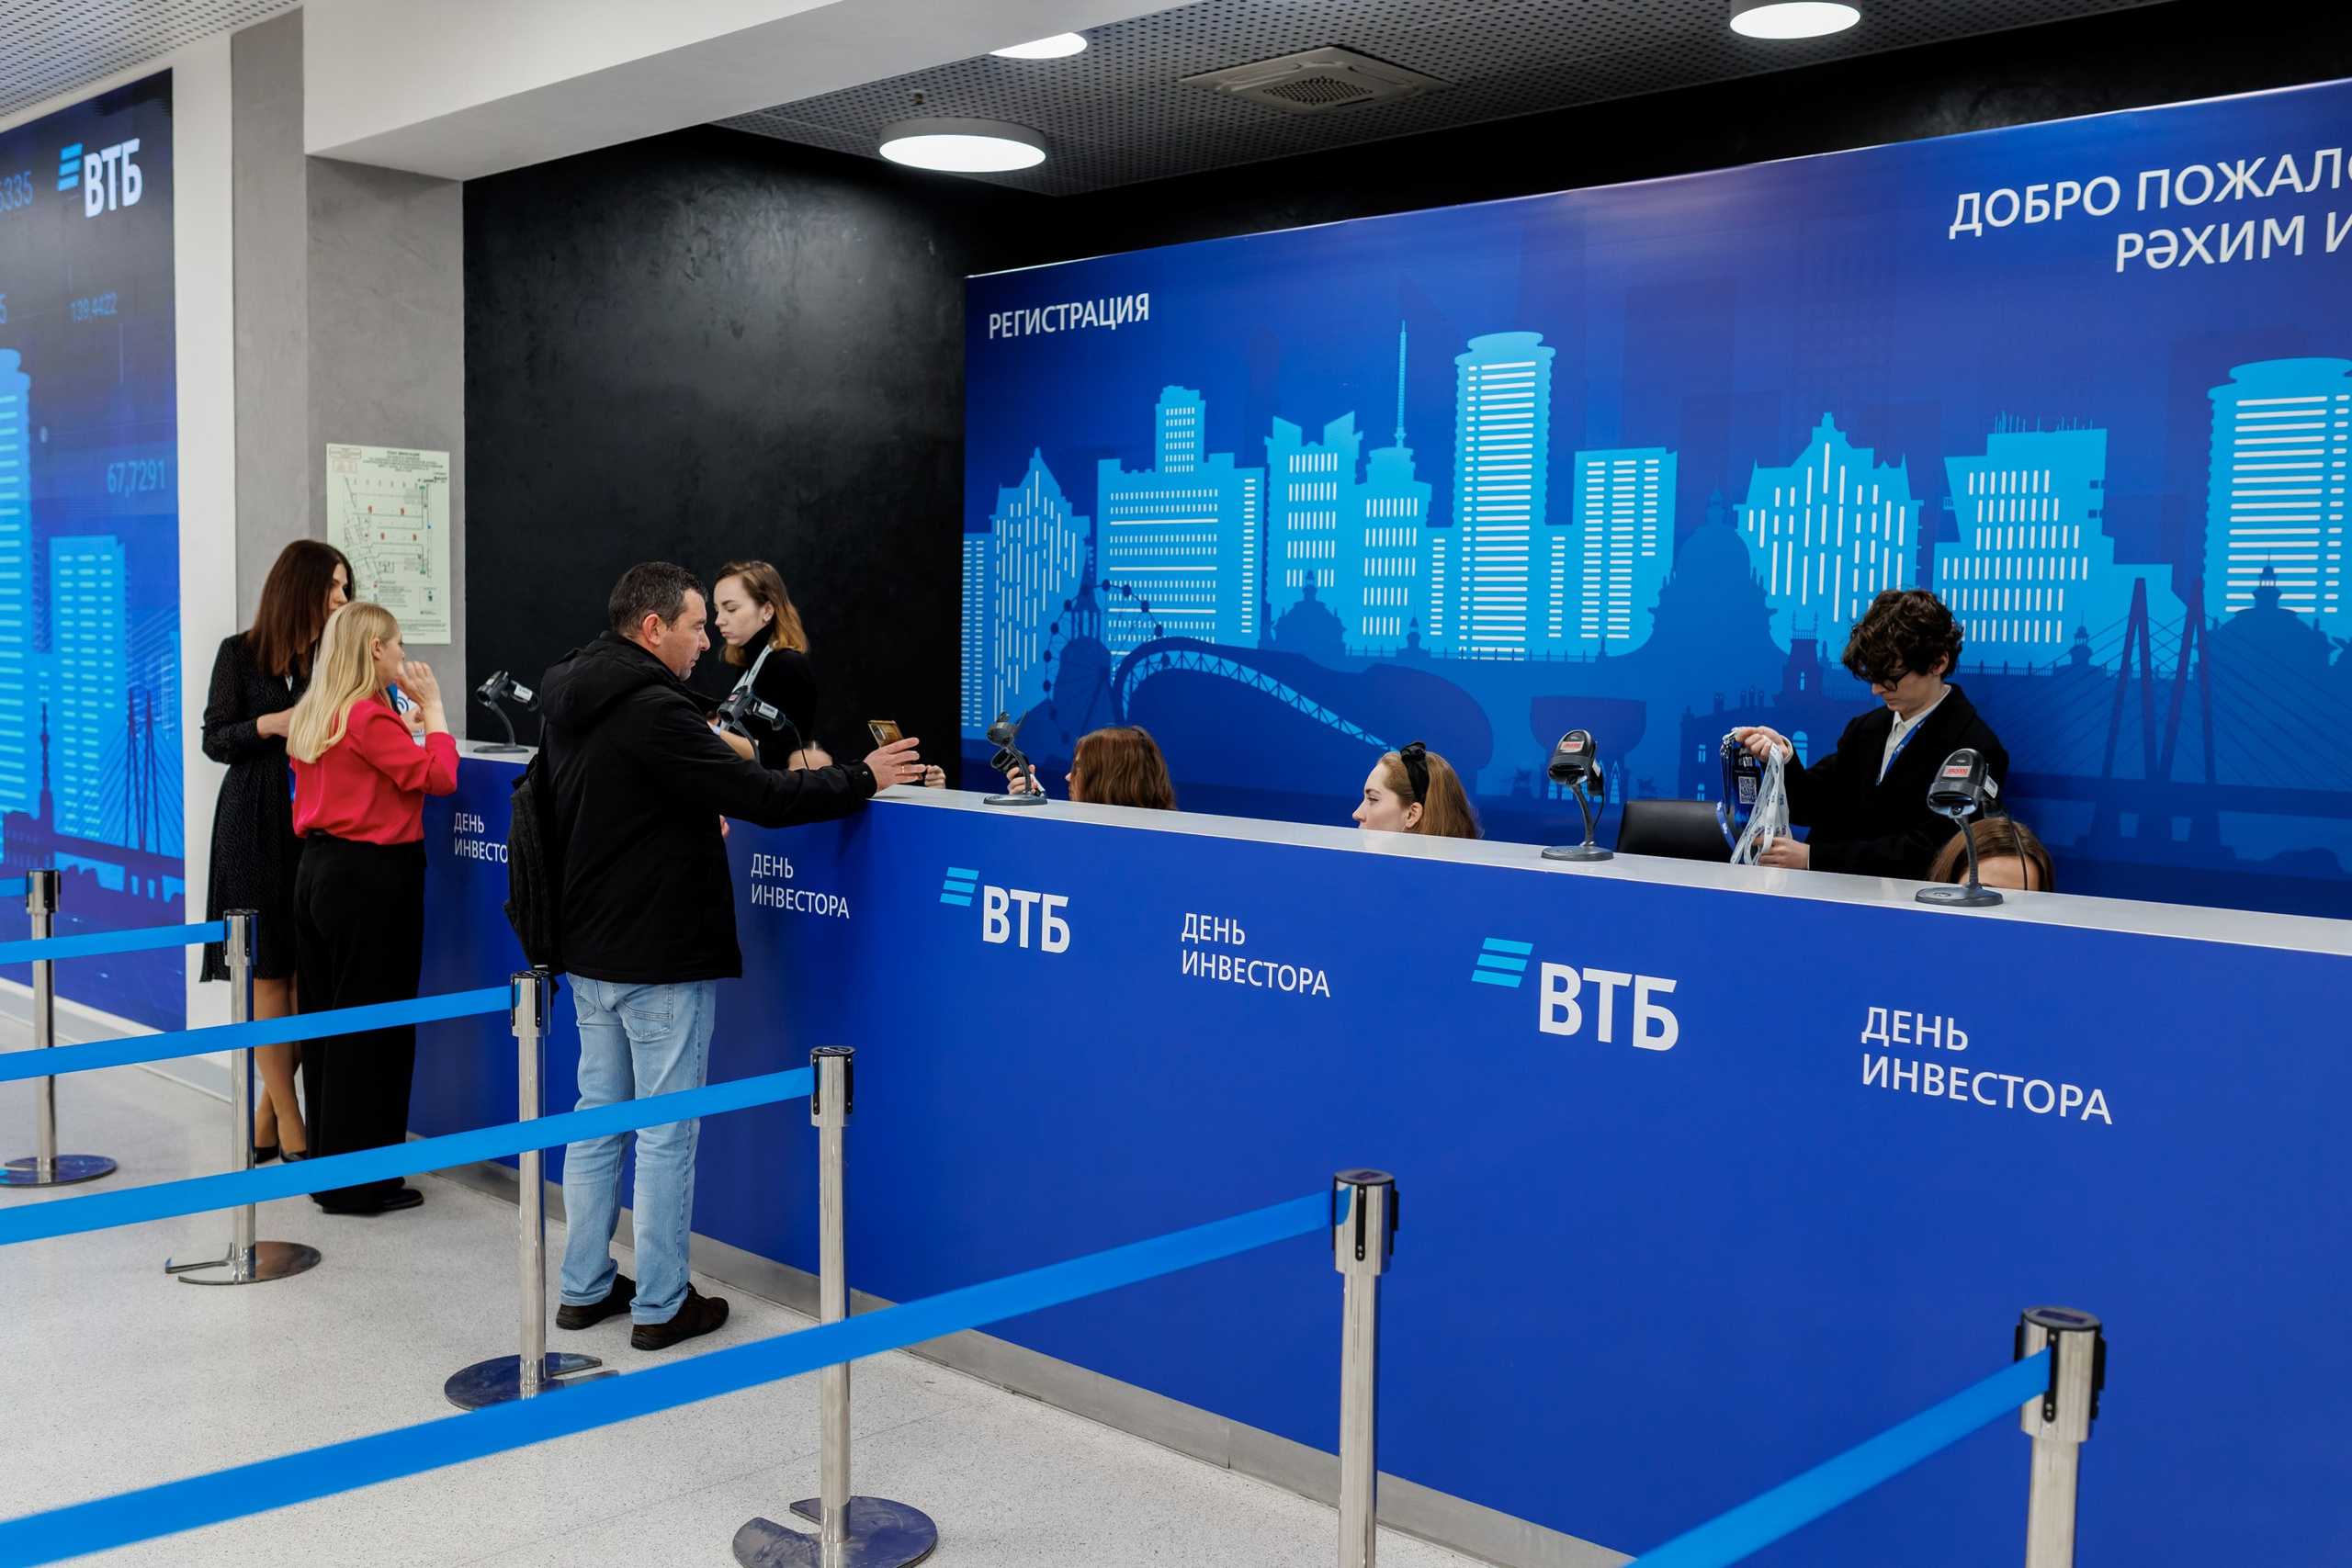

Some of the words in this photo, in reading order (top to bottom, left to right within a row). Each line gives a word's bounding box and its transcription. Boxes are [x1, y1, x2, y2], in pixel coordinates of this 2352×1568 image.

[84, 138, 142, 218] ВТБ
[1949, 175, 2121, 240] ДОБРО
[2136, 147, 2352, 211] ПОЖАЛ
[2116, 215, 2305, 273] РӘХИМ
[989, 292, 1149, 340] РЕГИСТРАЦИЯ
[107, 458, 165, 498] 67,7291
[454, 812, 485, 834] ДЕНЬ
[751, 852, 794, 878] ДЕНЬ
[751, 884, 850, 919] ИНВЕСТОРА
[982, 885, 1071, 953] ВТБ
[1182, 912, 1246, 945] ДЕНЬ
[1182, 949, 1330, 998] ИНВЕСТОРА
[1539, 962, 1679, 1052] ВТБ
[1861, 1006, 1969, 1052] ДЕНЬ
[1861, 1054, 2113, 1125] ИНВЕСТОРА
